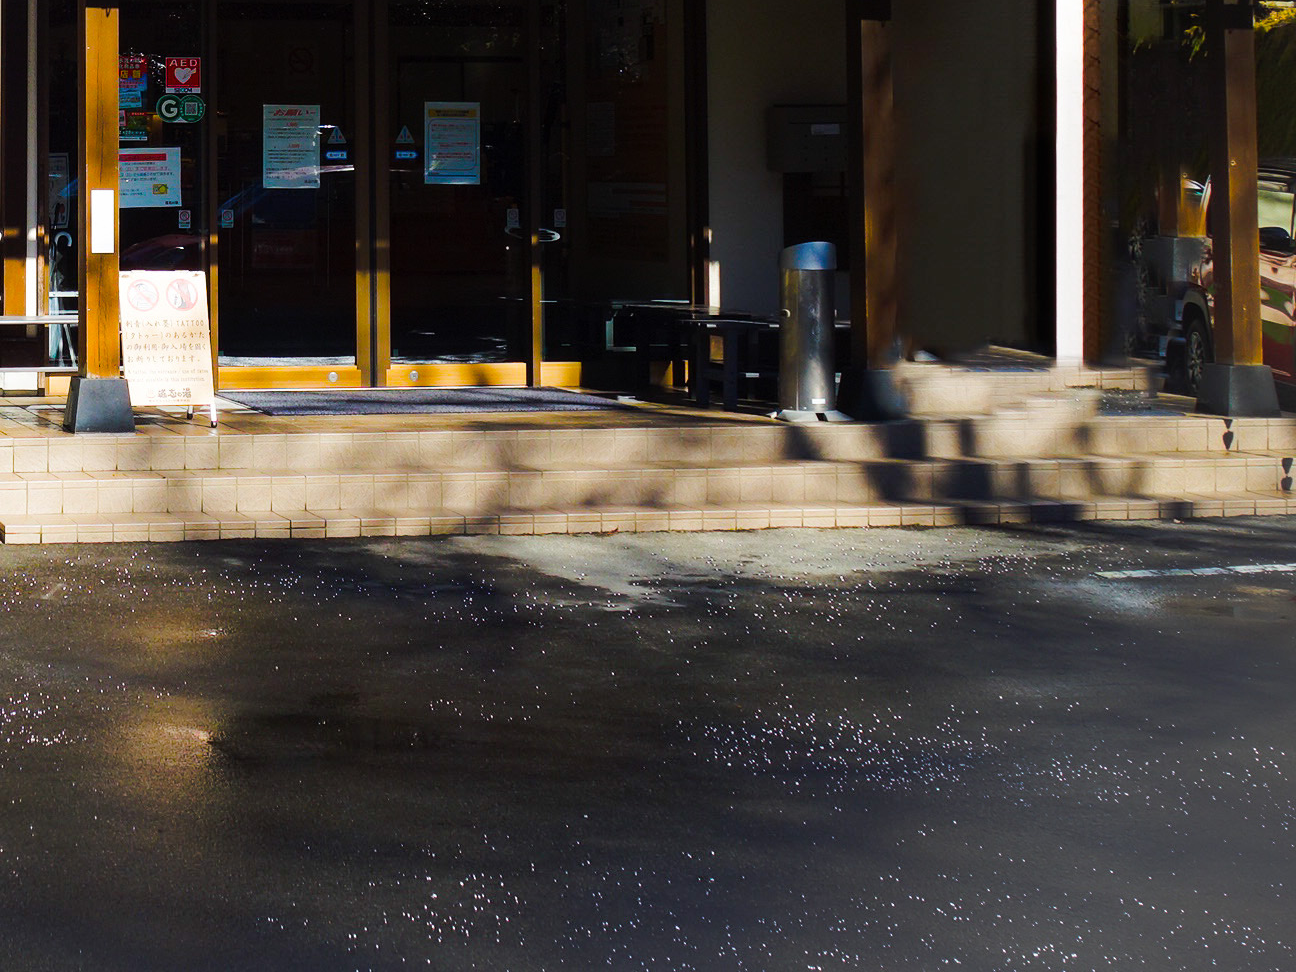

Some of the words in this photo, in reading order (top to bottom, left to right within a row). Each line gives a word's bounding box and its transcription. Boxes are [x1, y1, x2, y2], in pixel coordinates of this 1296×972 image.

[169, 59, 198, 67] AED
[161, 99, 178, 118] G
[176, 319, 204, 327] TATTOO
